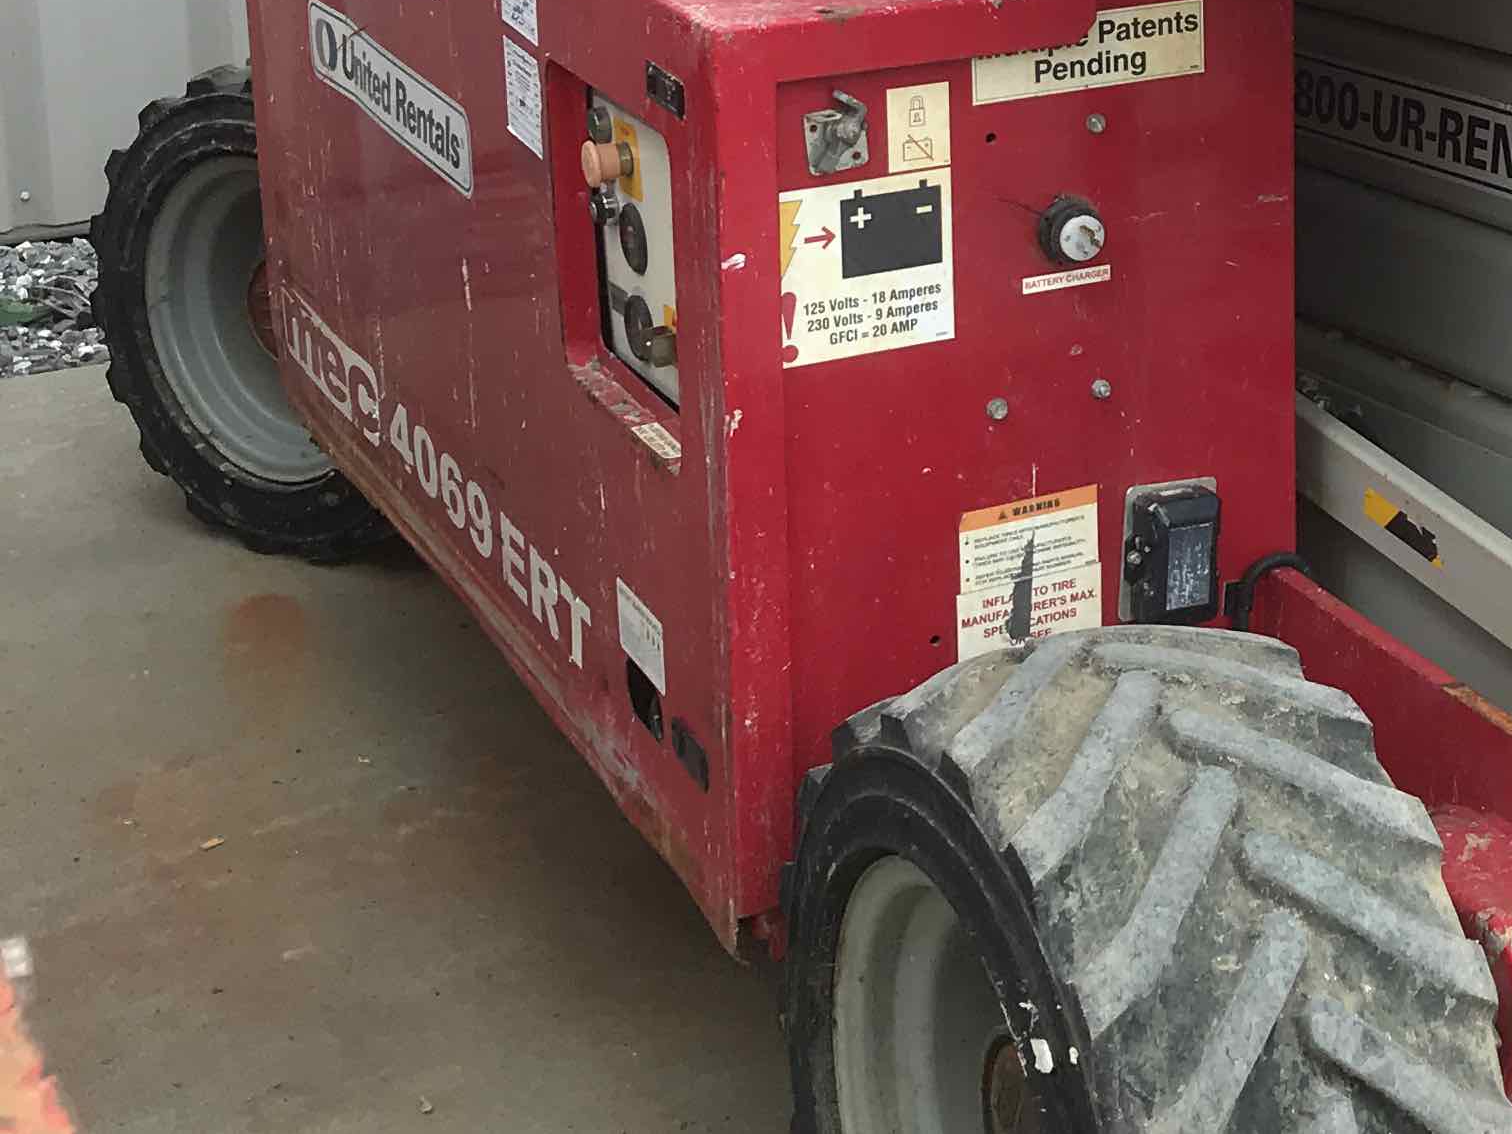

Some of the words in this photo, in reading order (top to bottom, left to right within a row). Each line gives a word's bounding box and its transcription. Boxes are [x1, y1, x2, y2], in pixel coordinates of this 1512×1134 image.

[1098, 11, 1199, 44] Patents
[341, 33, 392, 115] United
[1034, 49, 1147, 83] Pending
[1024, 274, 1065, 290] BATTERY
[1065, 268, 1109, 283] CHARGER
[803, 301, 826, 316] 125
[829, 296, 860, 312] Volts
[872, 291, 886, 305] 18
[890, 283, 942, 302] Amperes
[807, 316, 830, 333] 230
[834, 312, 864, 328] Volts
[875, 307, 883, 321] 9
[886, 299, 939, 319] Amperes
[829, 328, 858, 345] GFCI
[872, 324, 887, 338] 20
[890, 318, 918, 334] AMP
[1012, 497, 1061, 517] WARNING
[1032, 584, 1049, 597] TO
[1051, 577, 1078, 593] TIRE
[960, 595, 1068, 629] MANUFARER'S
[1070, 588, 1097, 603] MAX.
